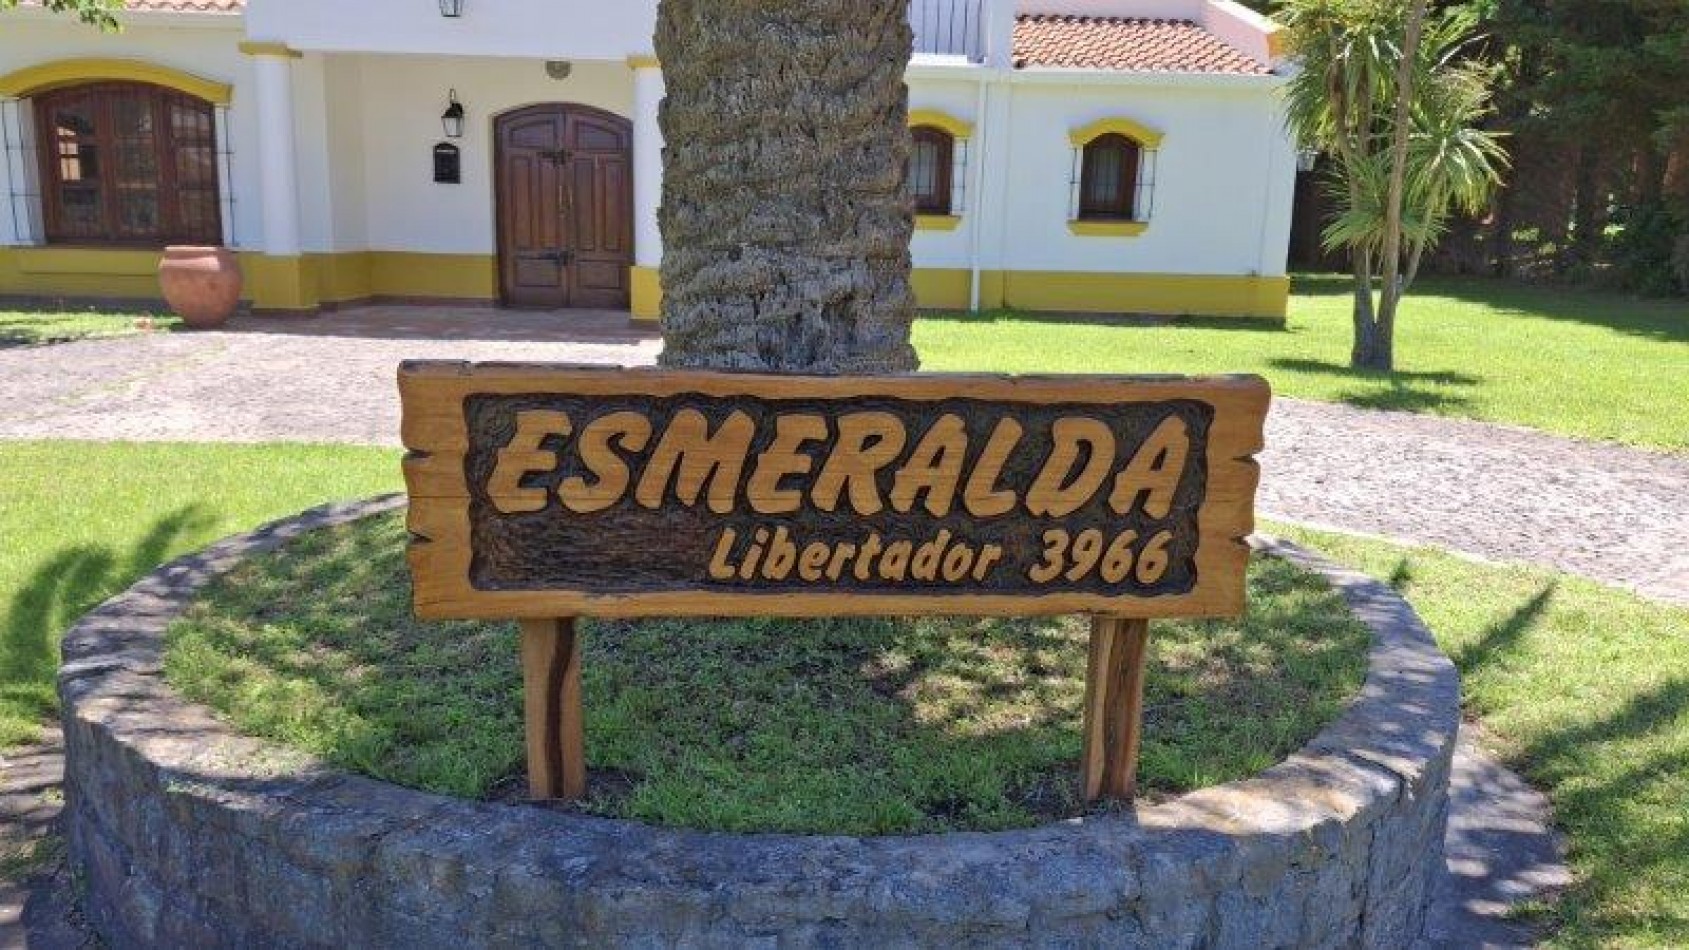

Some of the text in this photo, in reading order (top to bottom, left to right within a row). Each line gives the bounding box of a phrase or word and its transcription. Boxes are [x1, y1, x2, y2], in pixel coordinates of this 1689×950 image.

[488, 408, 1191, 519] ESMERALDA
[708, 527, 1172, 585] Libertador 3966
